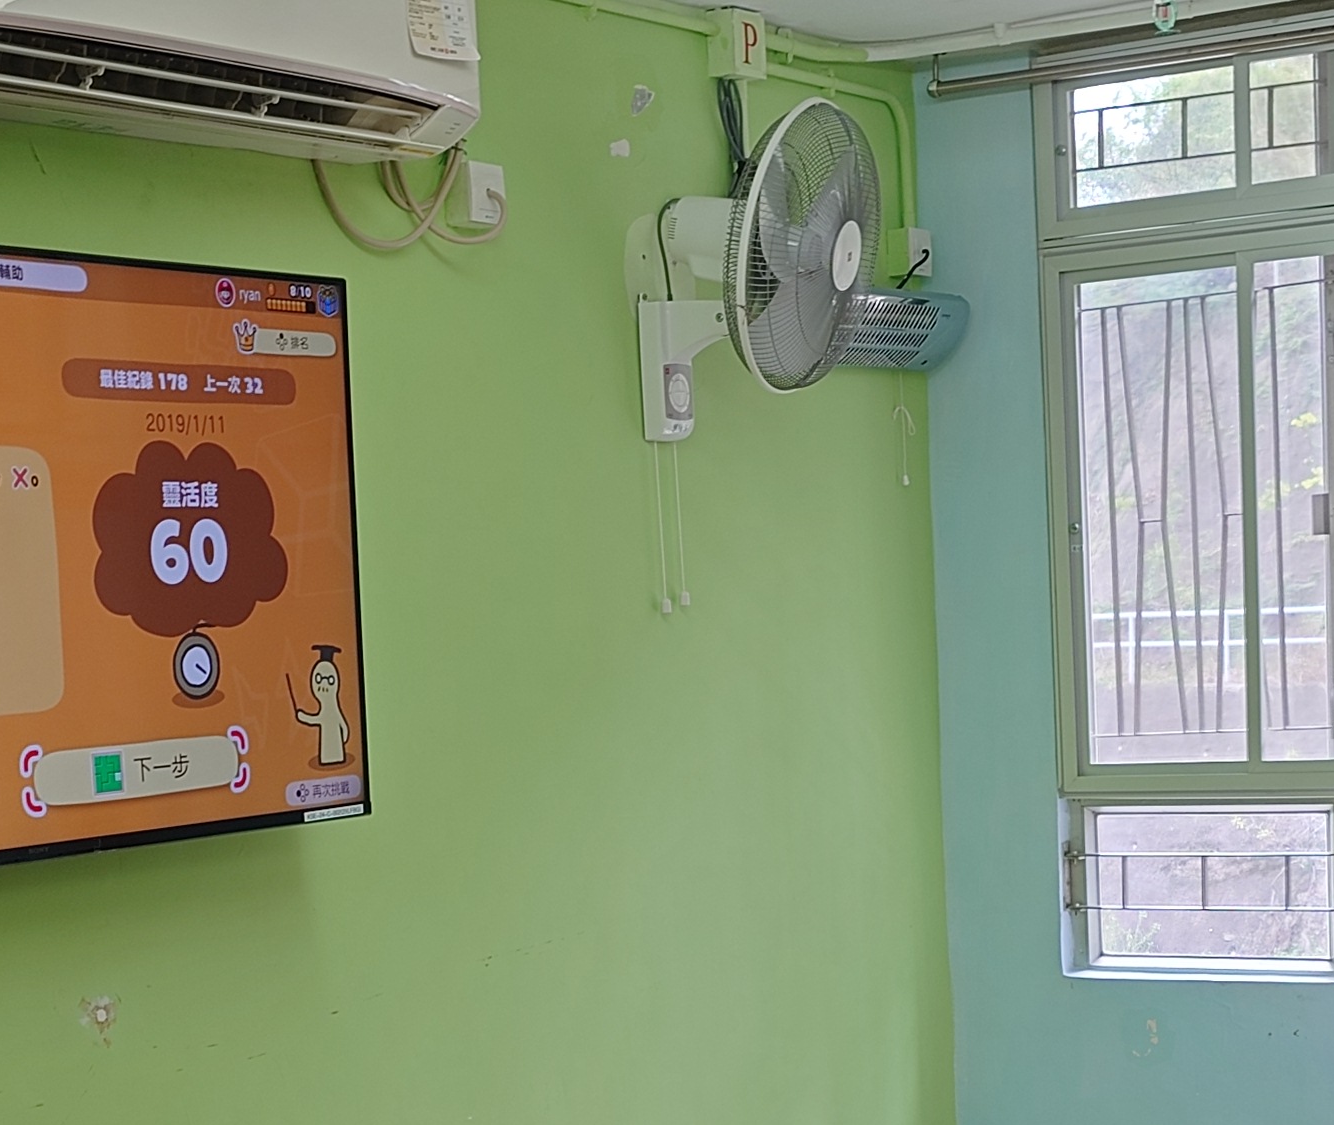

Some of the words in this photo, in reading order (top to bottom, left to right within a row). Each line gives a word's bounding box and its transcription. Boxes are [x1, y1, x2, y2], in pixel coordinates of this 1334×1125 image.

[741, 21, 758, 65] P
[239, 289, 261, 304] ryan
[289, 284, 312, 298] 8/10
[99, 368, 155, 390] 最佳紀錄
[158, 373, 188, 391] 178
[203, 374, 241, 393] 上一次
[244, 377, 264, 395] 32
[145, 412, 226, 437] 2019/1/11
[31, 475, 39, 487] 0
[161, 481, 219, 508] 靈活度
[150, 518, 228, 585] 60
[132, 753, 190, 783] 下一步
